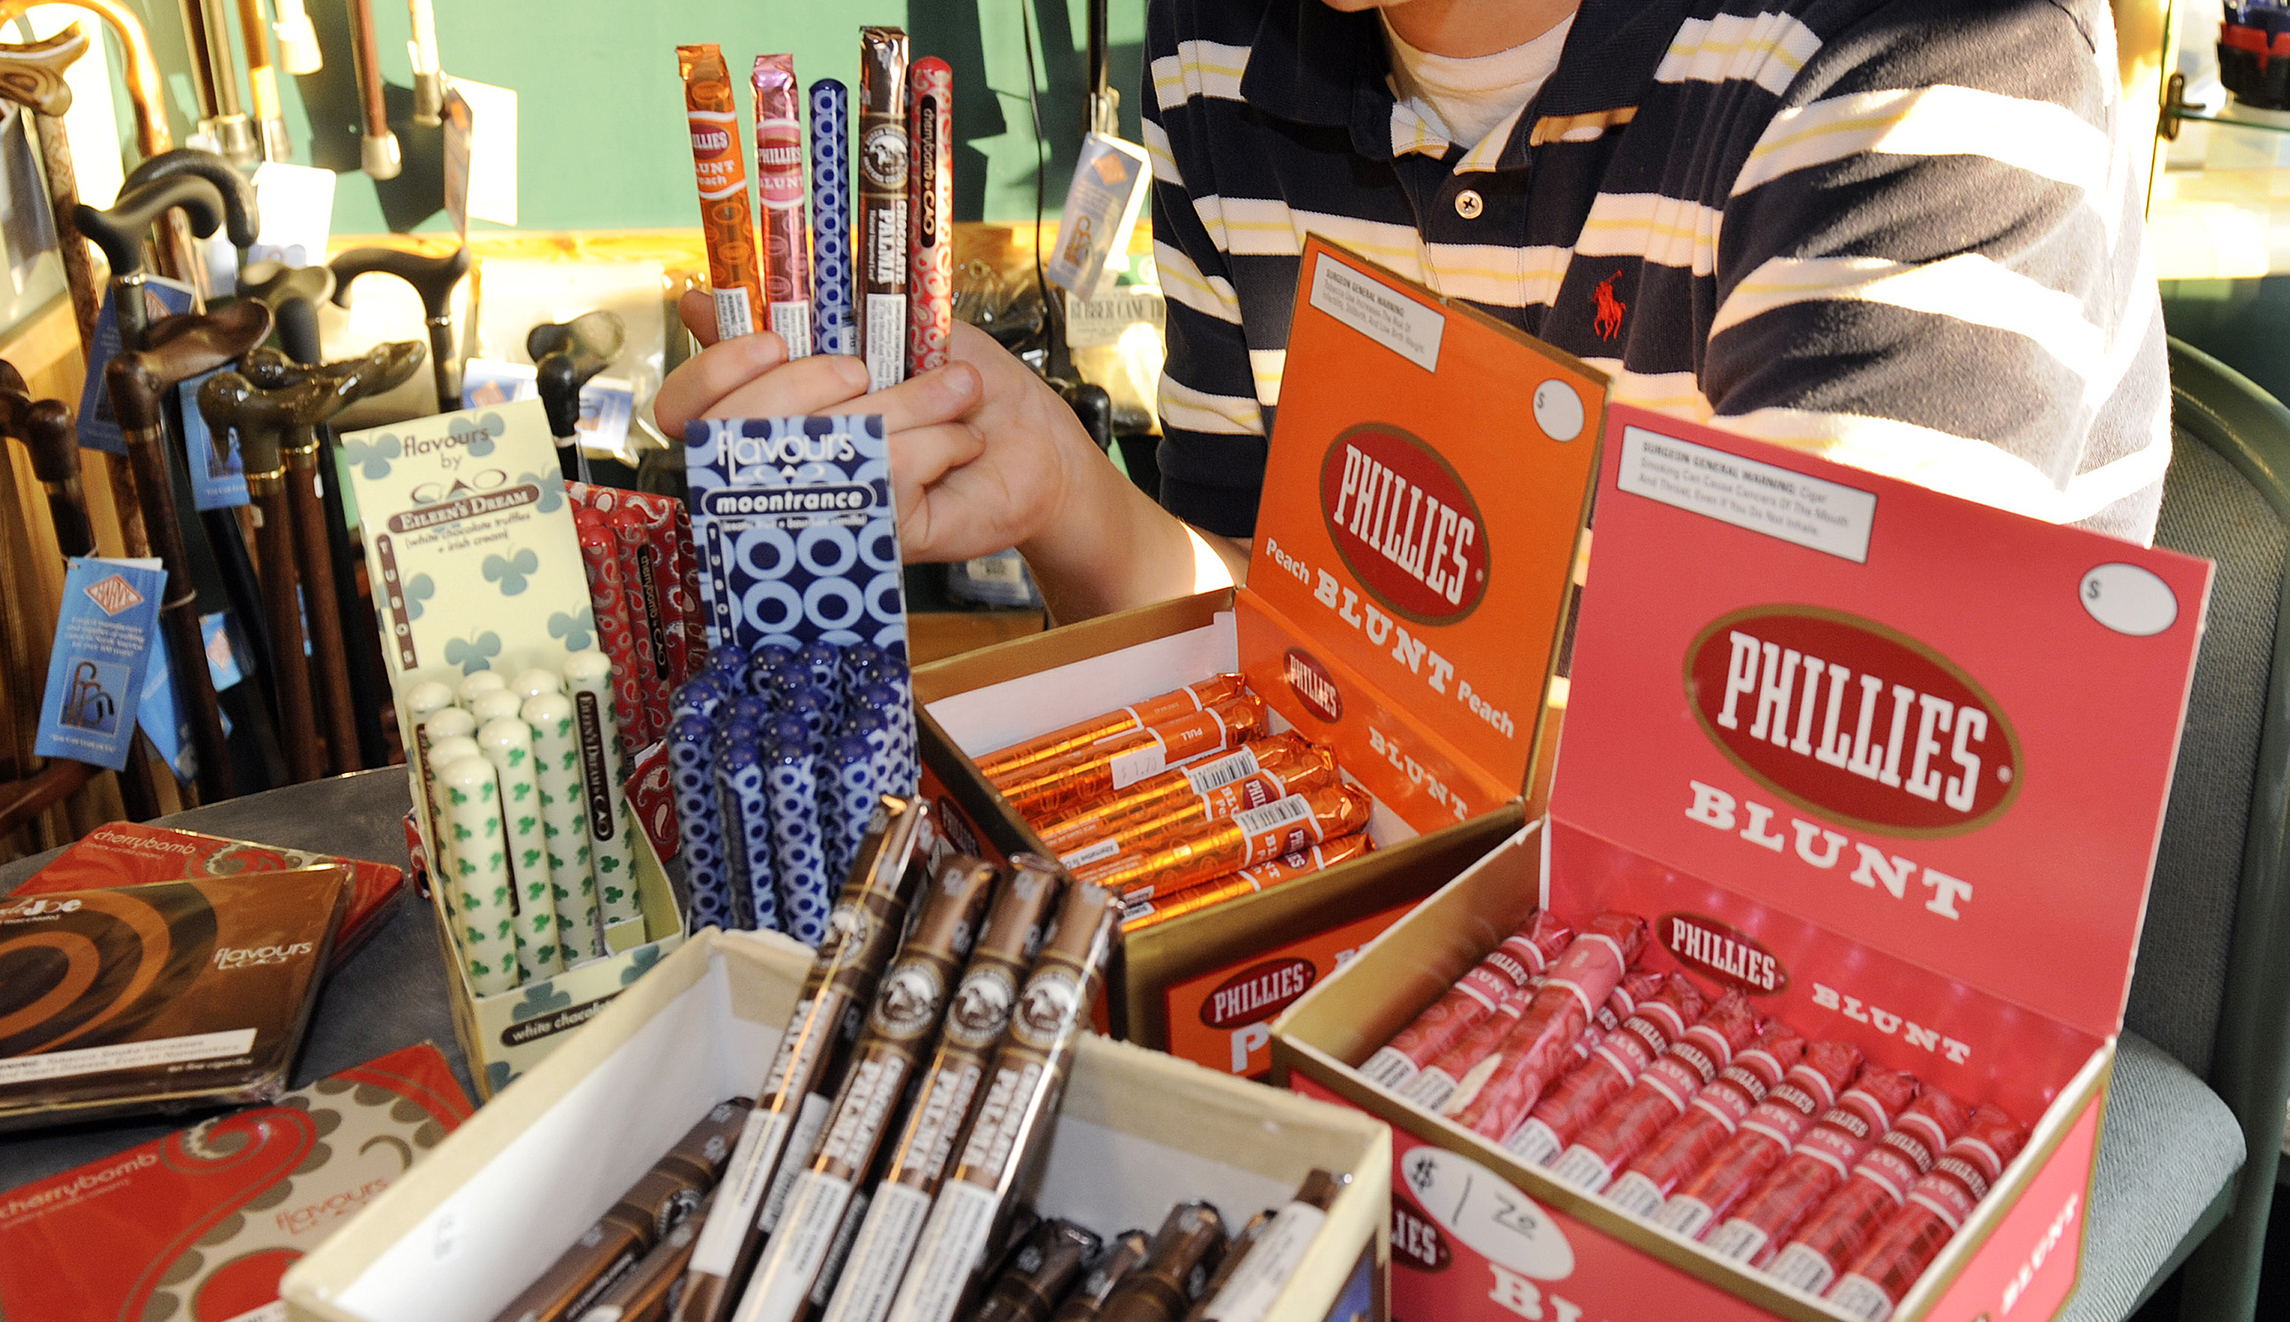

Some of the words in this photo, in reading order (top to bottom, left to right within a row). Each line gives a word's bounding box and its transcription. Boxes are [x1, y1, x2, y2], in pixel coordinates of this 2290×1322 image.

[692, 131, 728, 150] ILLIES
[696, 160, 734, 173] UNT
[896, 200, 907, 285] CHOCOLATE
[923, 190, 935, 236] CAO
[878, 208, 894, 284] PALMA
[404, 426, 490, 457] flavours
[441, 452, 463, 470] by
[717, 430, 856, 482] flavours
[1642, 440, 1691, 465] SURGEON
[411, 469, 507, 504] CAO
[716, 490, 864, 515] moontrance
[1333, 443, 1476, 606] PHILLIES
[640, 555, 658, 618] cherrybomb
[652, 628, 665, 666] CAO
[1265, 537, 1310, 585] Peach
[1313, 568, 1454, 694] BLUNT
[1457, 679, 1515, 739] Peach
[1290, 653, 1337, 720] PHILLIES
[1180, 727, 1203, 742] PULL
[1717, 630, 1988, 813] PHILLIES
[1221, 786, 1240, 816] BLU
[1246, 779, 1266, 808] PHIL
[1368, 725, 1470, 823] BLUNT
[94, 830, 196, 855] cherrybomb
[1684, 780, 1973, 920] BLUNT
[23, 899, 82, 916] Joe
[213, 942, 312, 970] flavours
[1671, 917, 1777, 991] PHILLIES
[1213, 963, 1304, 1023] PHILLIES
[1468, 967, 1510, 1002] LUNT
[513, 1022, 552, 1041] white
[762, 995, 815, 1098] PALMA
[1811, 982, 1971, 1065] BLUNT
[822, 1056, 884, 1164] PALMA
[843, 1052, 907, 1172] CHOCOLATE
[901, 1067, 961, 1175] PALMA
[921, 1062, 984, 1182] CHOCOLATE
[959, 1065, 1020, 1173] PALMA
[982, 1060, 1044, 1179] CHOCOLATE
[276, 1179, 388, 1235] flavours
